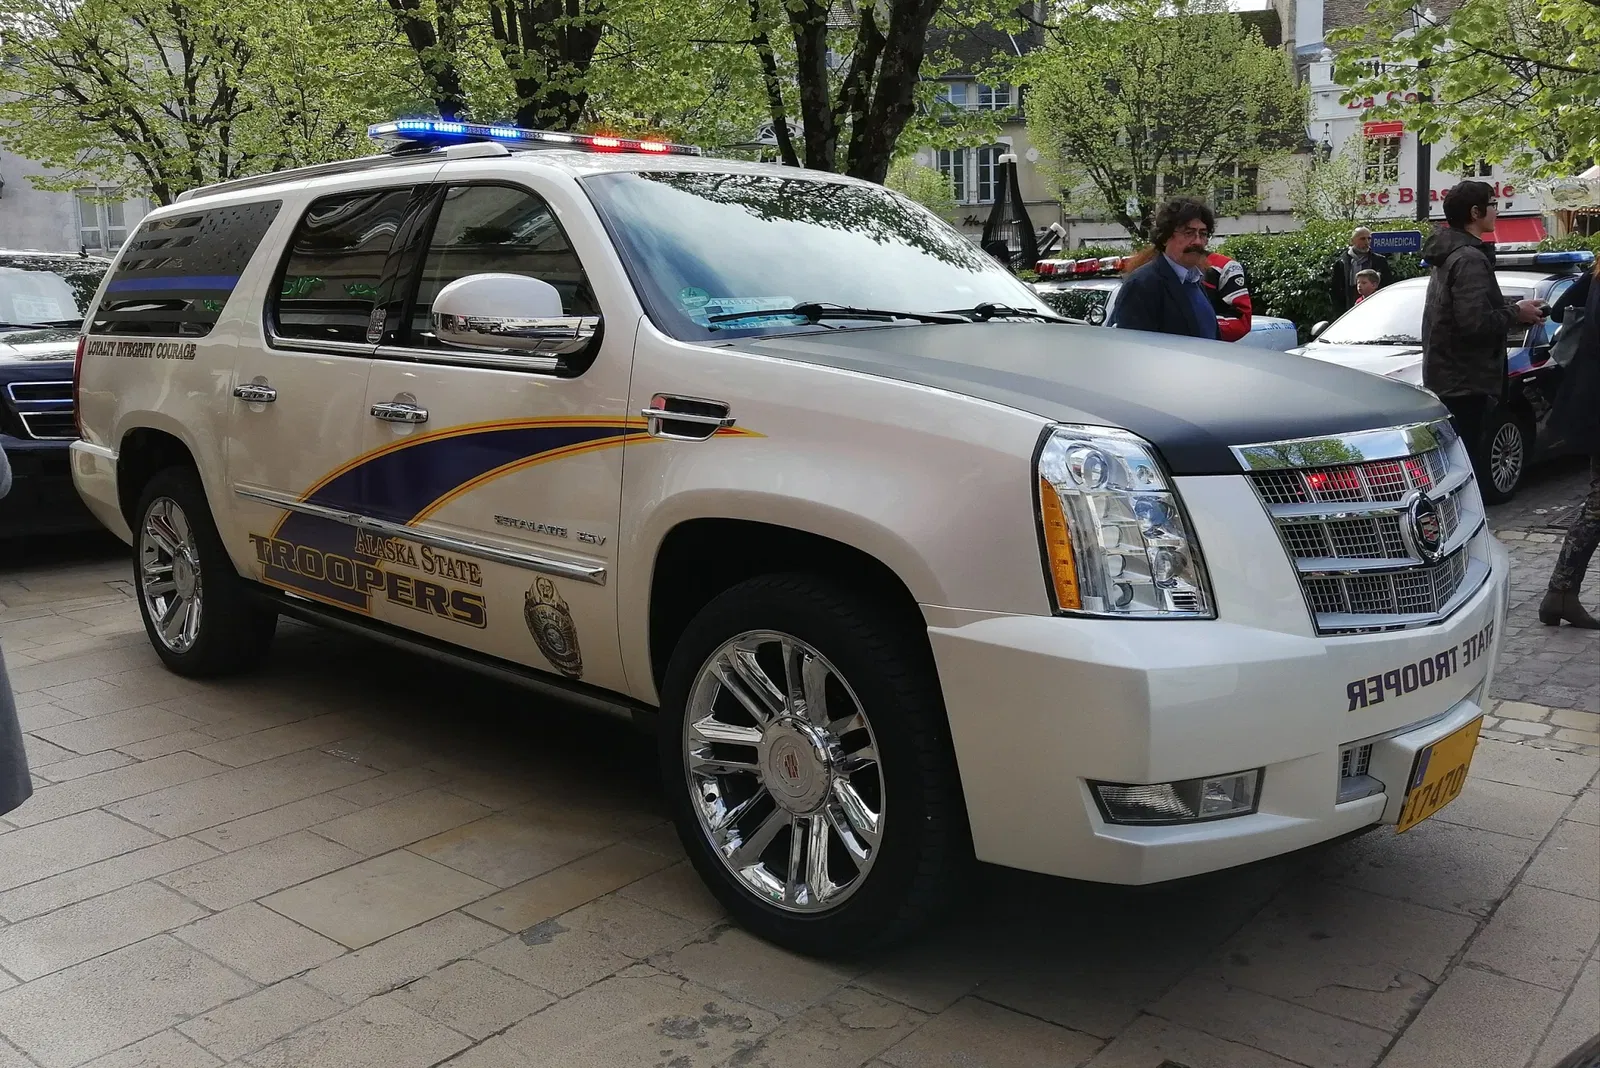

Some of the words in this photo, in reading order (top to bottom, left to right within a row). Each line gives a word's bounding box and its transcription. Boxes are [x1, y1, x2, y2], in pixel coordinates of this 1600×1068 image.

[1373, 236, 1417, 247] PARAMEDICAL
[87, 341, 117, 357] LOYALTY
[116, 341, 156, 359] INTEGRITY
[156, 342, 197, 361] COURAGE
[249, 533, 488, 630] TROOPERS
[355, 527, 420, 569] ALASKA
[421, 544, 483, 588] STATE
[1406, 763, 1466, 825] 17470
